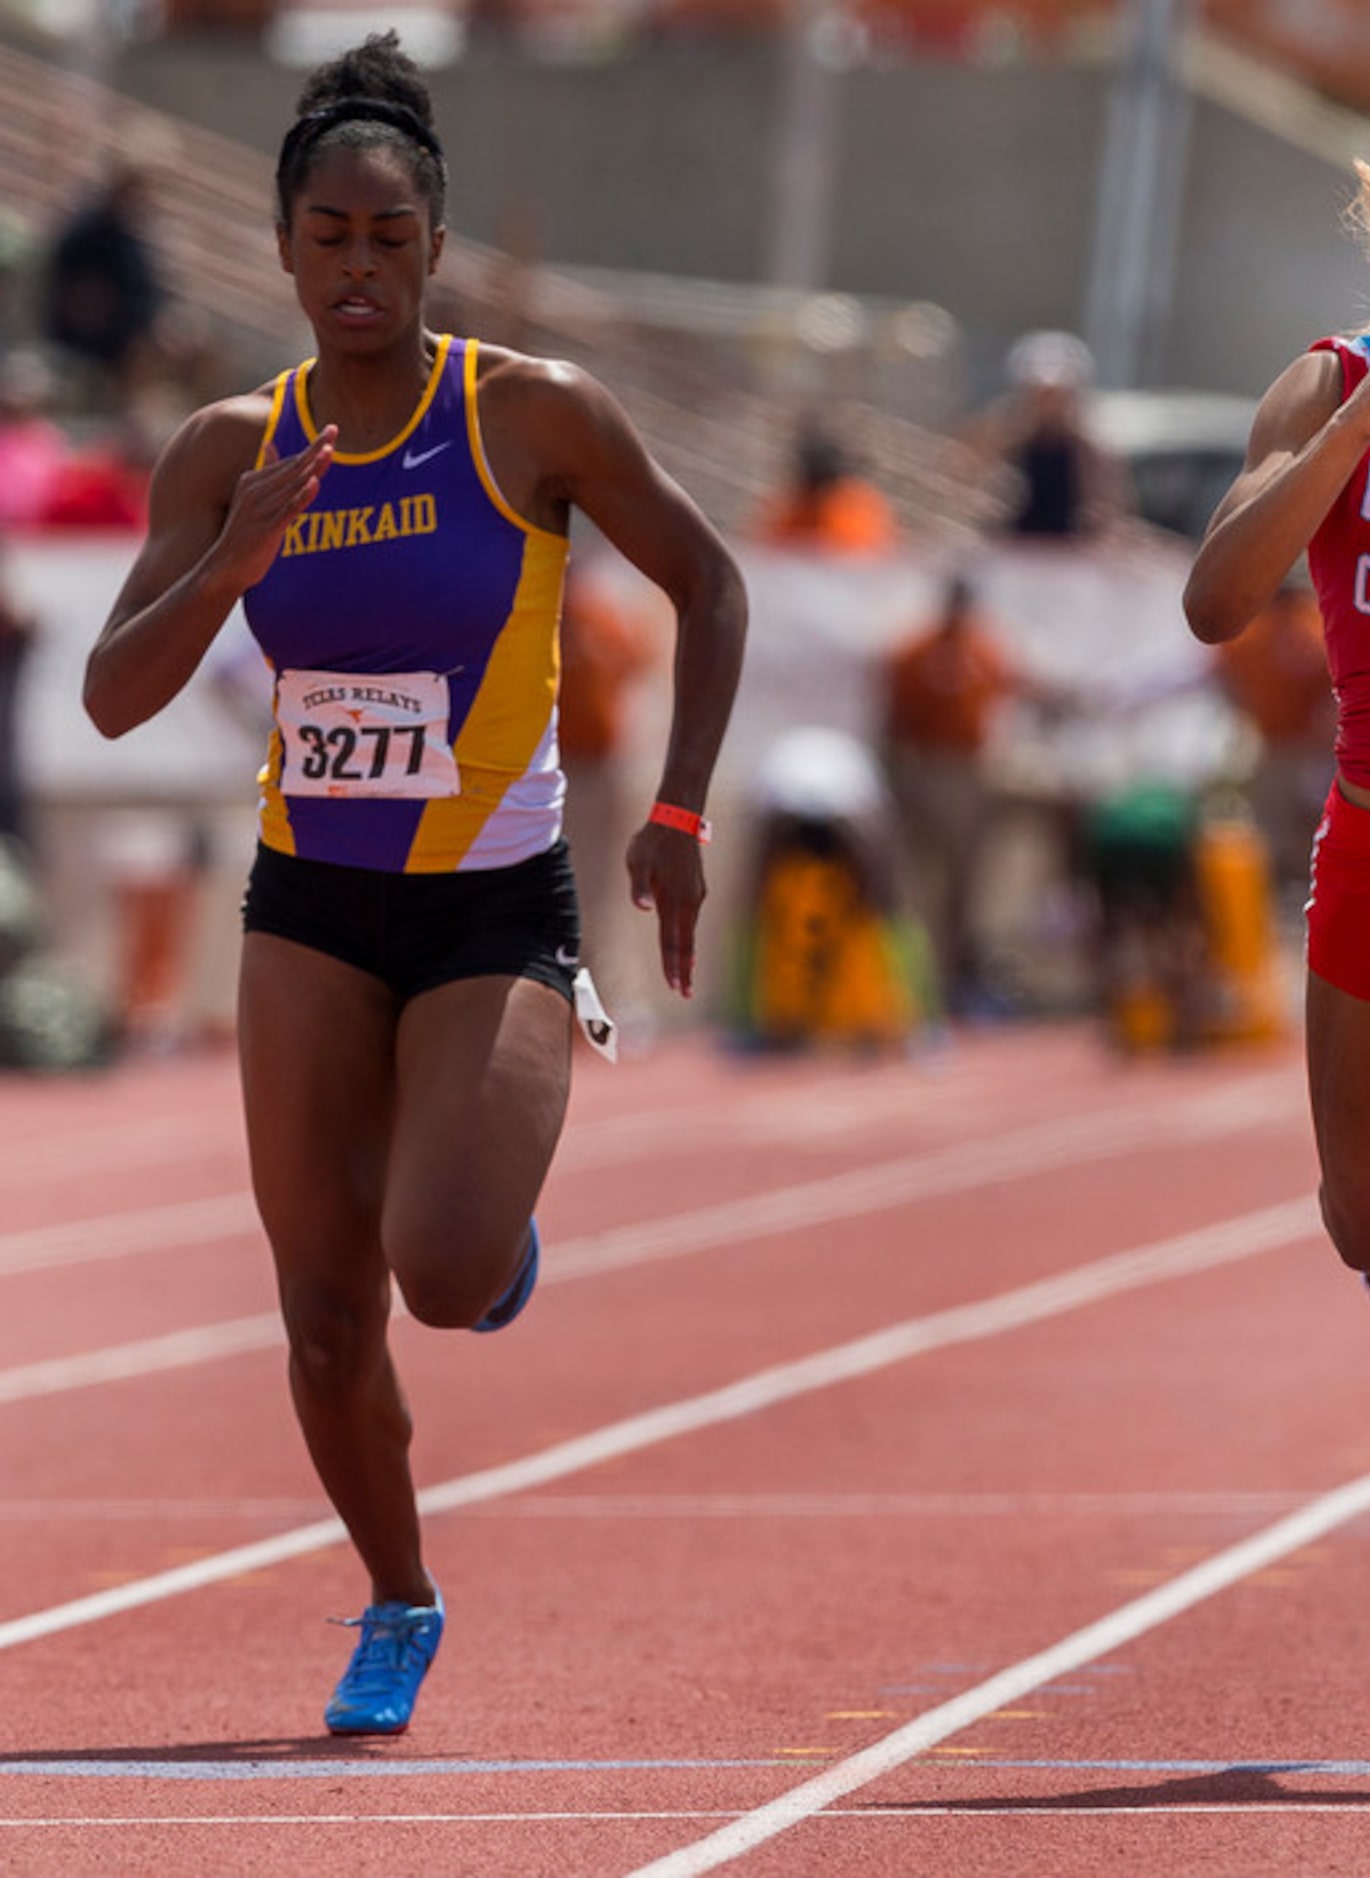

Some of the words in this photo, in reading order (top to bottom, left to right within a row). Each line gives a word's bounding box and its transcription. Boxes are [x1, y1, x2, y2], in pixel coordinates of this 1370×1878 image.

[281, 493, 438, 557] KINKAID
[302, 688, 346, 710] TEXAS
[352, 687, 423, 714] RELAYS
[298, 725, 426, 780] 3277
